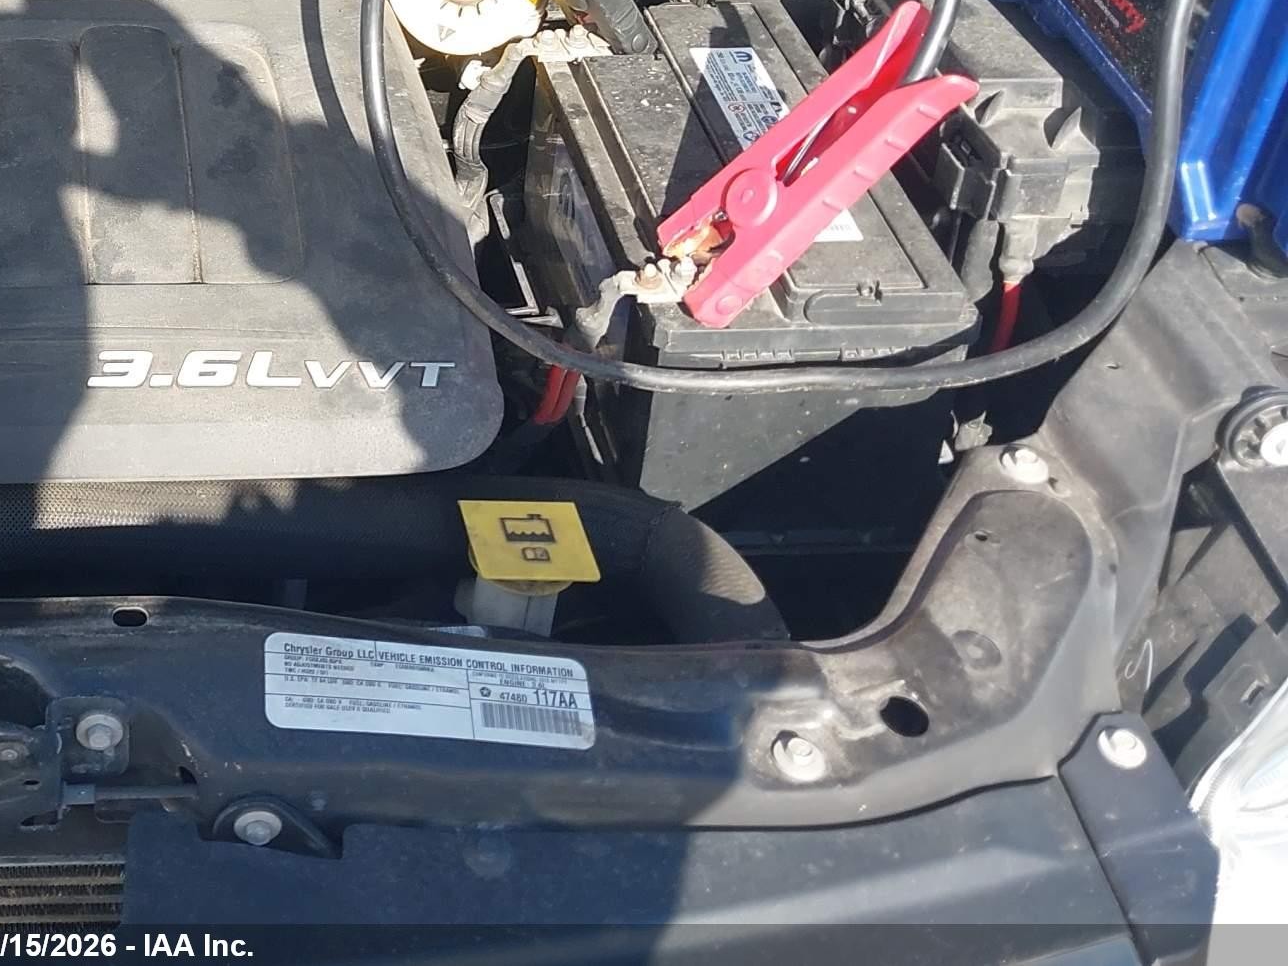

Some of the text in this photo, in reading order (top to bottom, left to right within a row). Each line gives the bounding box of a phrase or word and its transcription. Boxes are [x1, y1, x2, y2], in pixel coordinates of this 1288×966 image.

[283, 642, 323, 656] Chrysler
[325, 646, 354, 660] Group
[356, 649, 375, 660] LLC
[378, 652, 417, 664] VEHICLE
[419, 654, 463, 667] EMISSION
[466, 659, 508, 673] CONTROL
[511, 663, 574, 678] INFORMATION
[533, 688, 578, 709] 117AA
